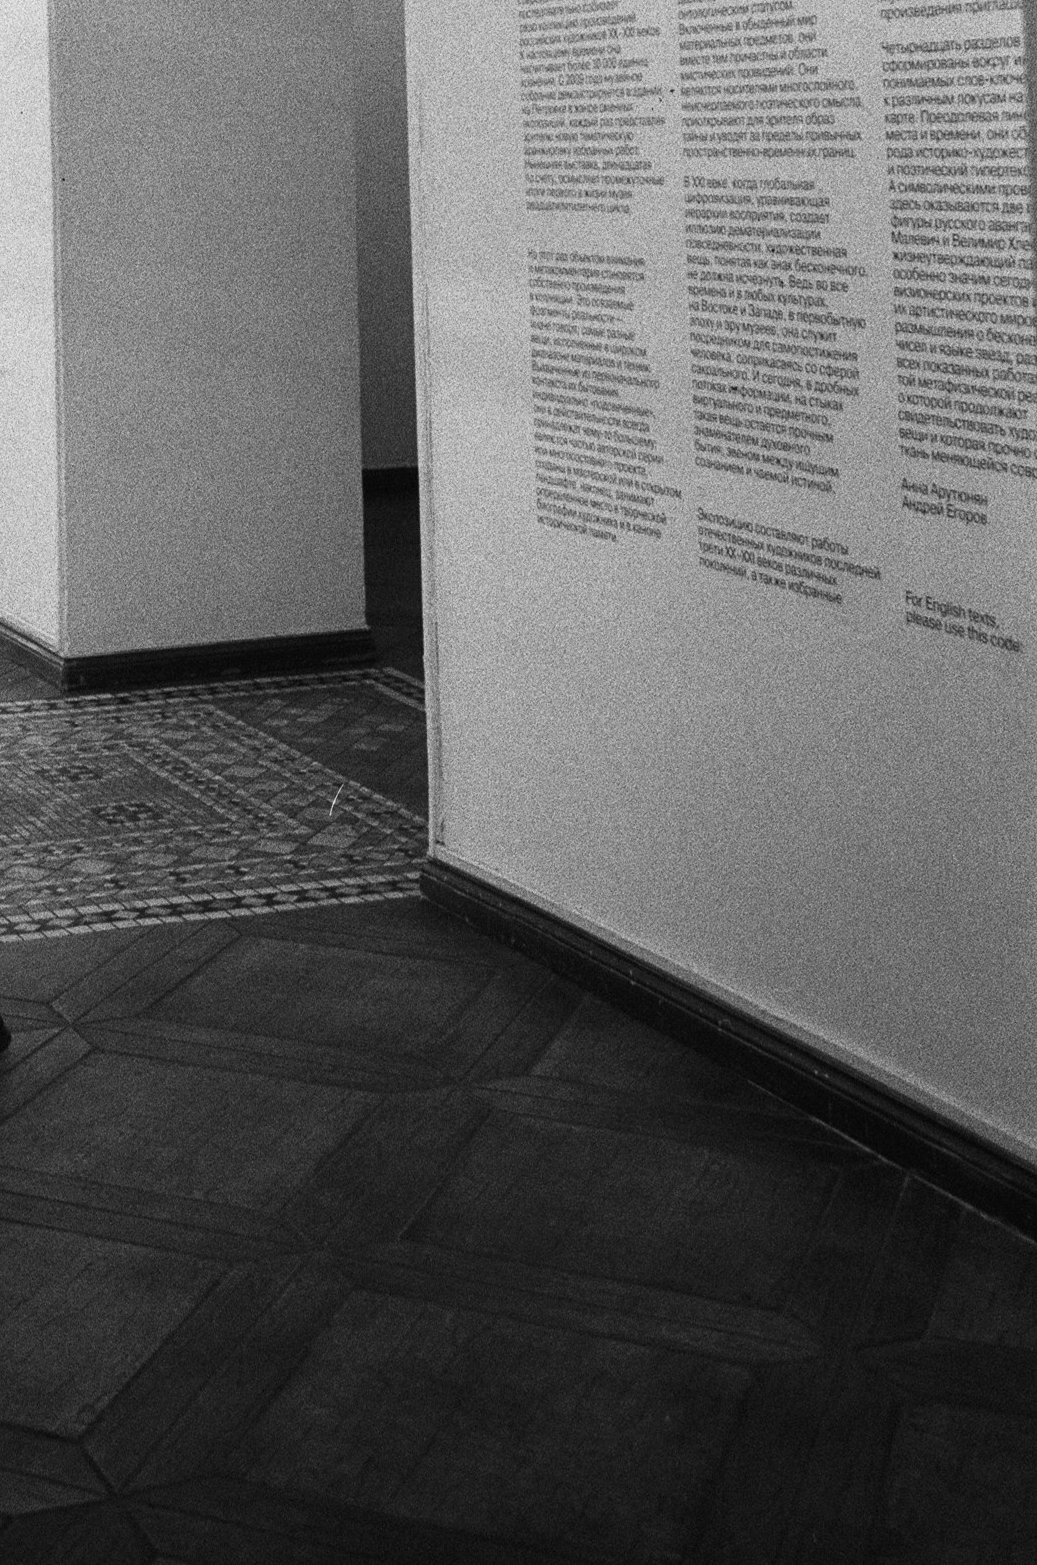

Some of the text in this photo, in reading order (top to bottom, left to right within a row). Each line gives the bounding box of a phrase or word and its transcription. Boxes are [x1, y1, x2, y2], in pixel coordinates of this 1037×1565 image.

[899, 477, 989, 509] Анна Арутюнян
[901, 496, 988, 528] Андрей Егоров
[904, 589, 922, 606] For
[924, 595, 965, 620] English
[905, 609, 942, 633] please
[944, 622, 965, 637] use
[967, 625, 988, 643] this
